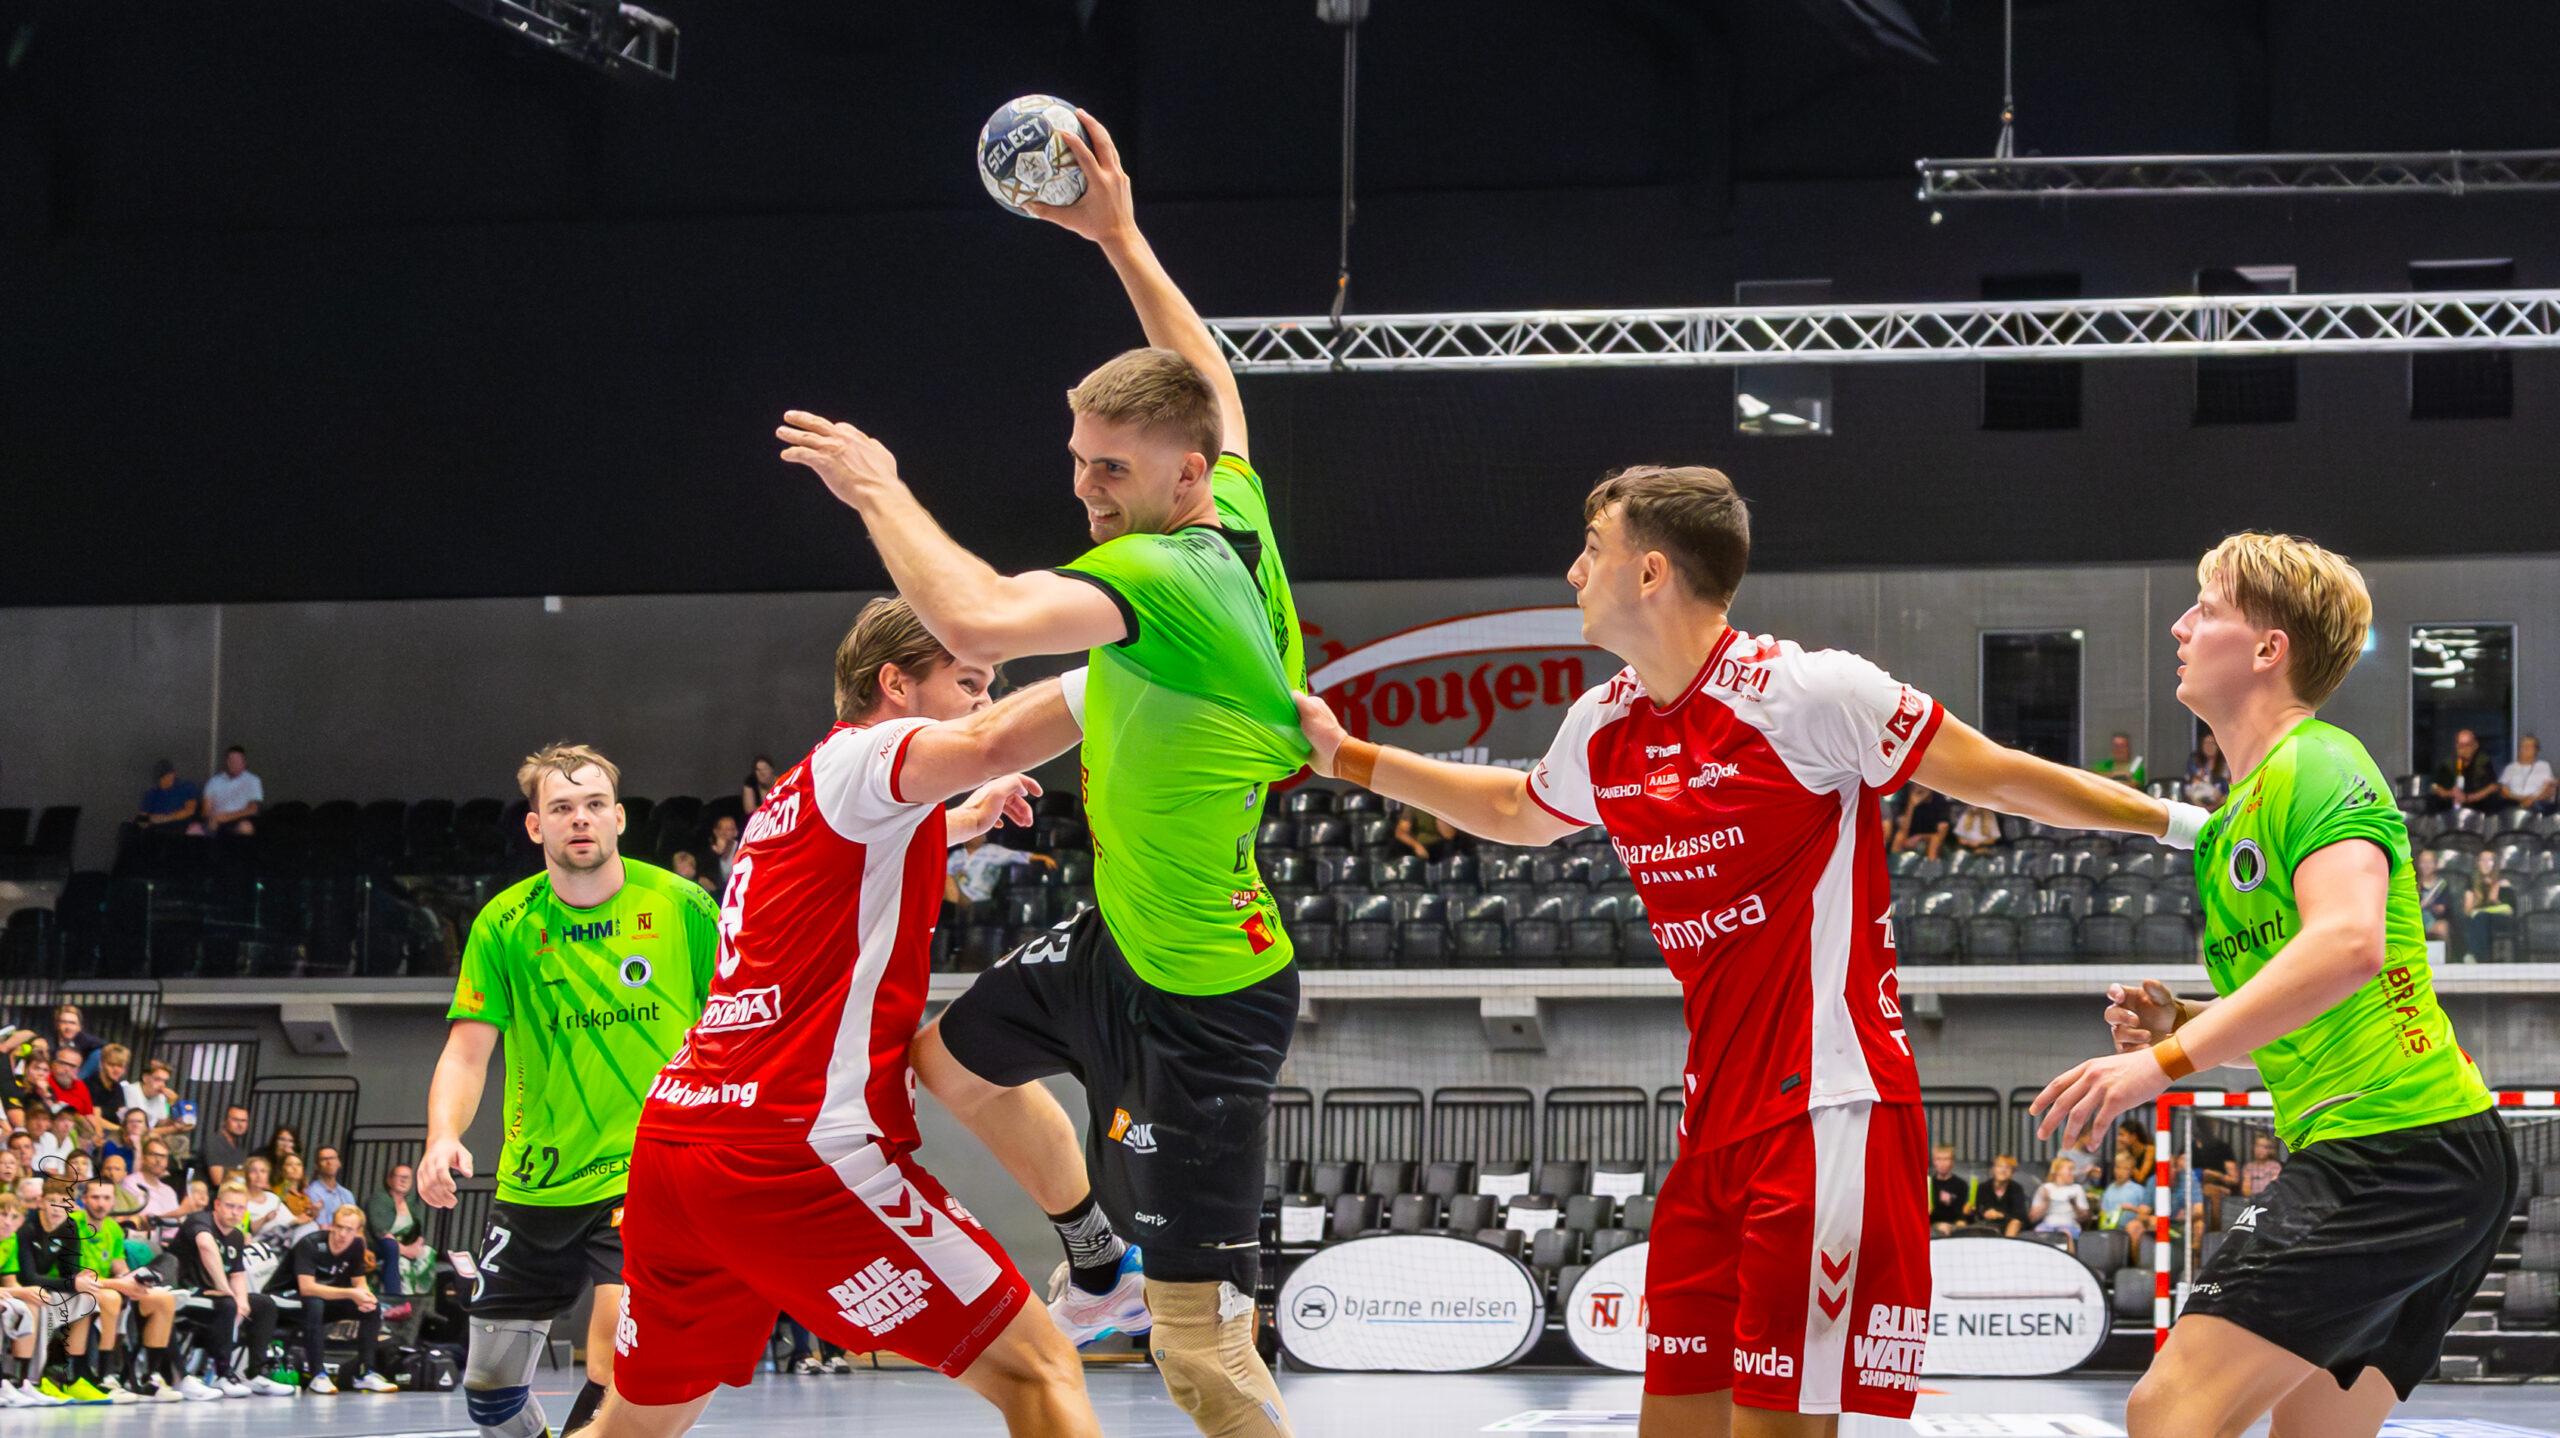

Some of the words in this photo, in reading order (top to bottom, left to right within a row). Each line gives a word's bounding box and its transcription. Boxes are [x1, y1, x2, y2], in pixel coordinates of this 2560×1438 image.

[987, 118, 1047, 174] SELECT
[1612, 825, 1745, 869] Sparekassen
[1640, 864, 1718, 885] DANMARK
[562, 919, 613, 943] HHM
[566, 1001, 660, 1030] riskpoint
[512, 1144, 559, 1188] 42
[827, 1257, 901, 1310] BLUE
[837, 1269, 933, 1328] WATER
[868, 1297, 929, 1337] SHIPPING
[1344, 1296, 1422, 1320] bjarne
[1431, 1297, 1517, 1318] nielsen
[1867, 1304, 1927, 1340] BLUE
[1958, 1313, 2073, 1336] NIELSEN
[1663, 1336, 1707, 1354] BYG
[1853, 1335, 1925, 1375] WATE
[1858, 1370, 1920, 1392] SHIPPIN
